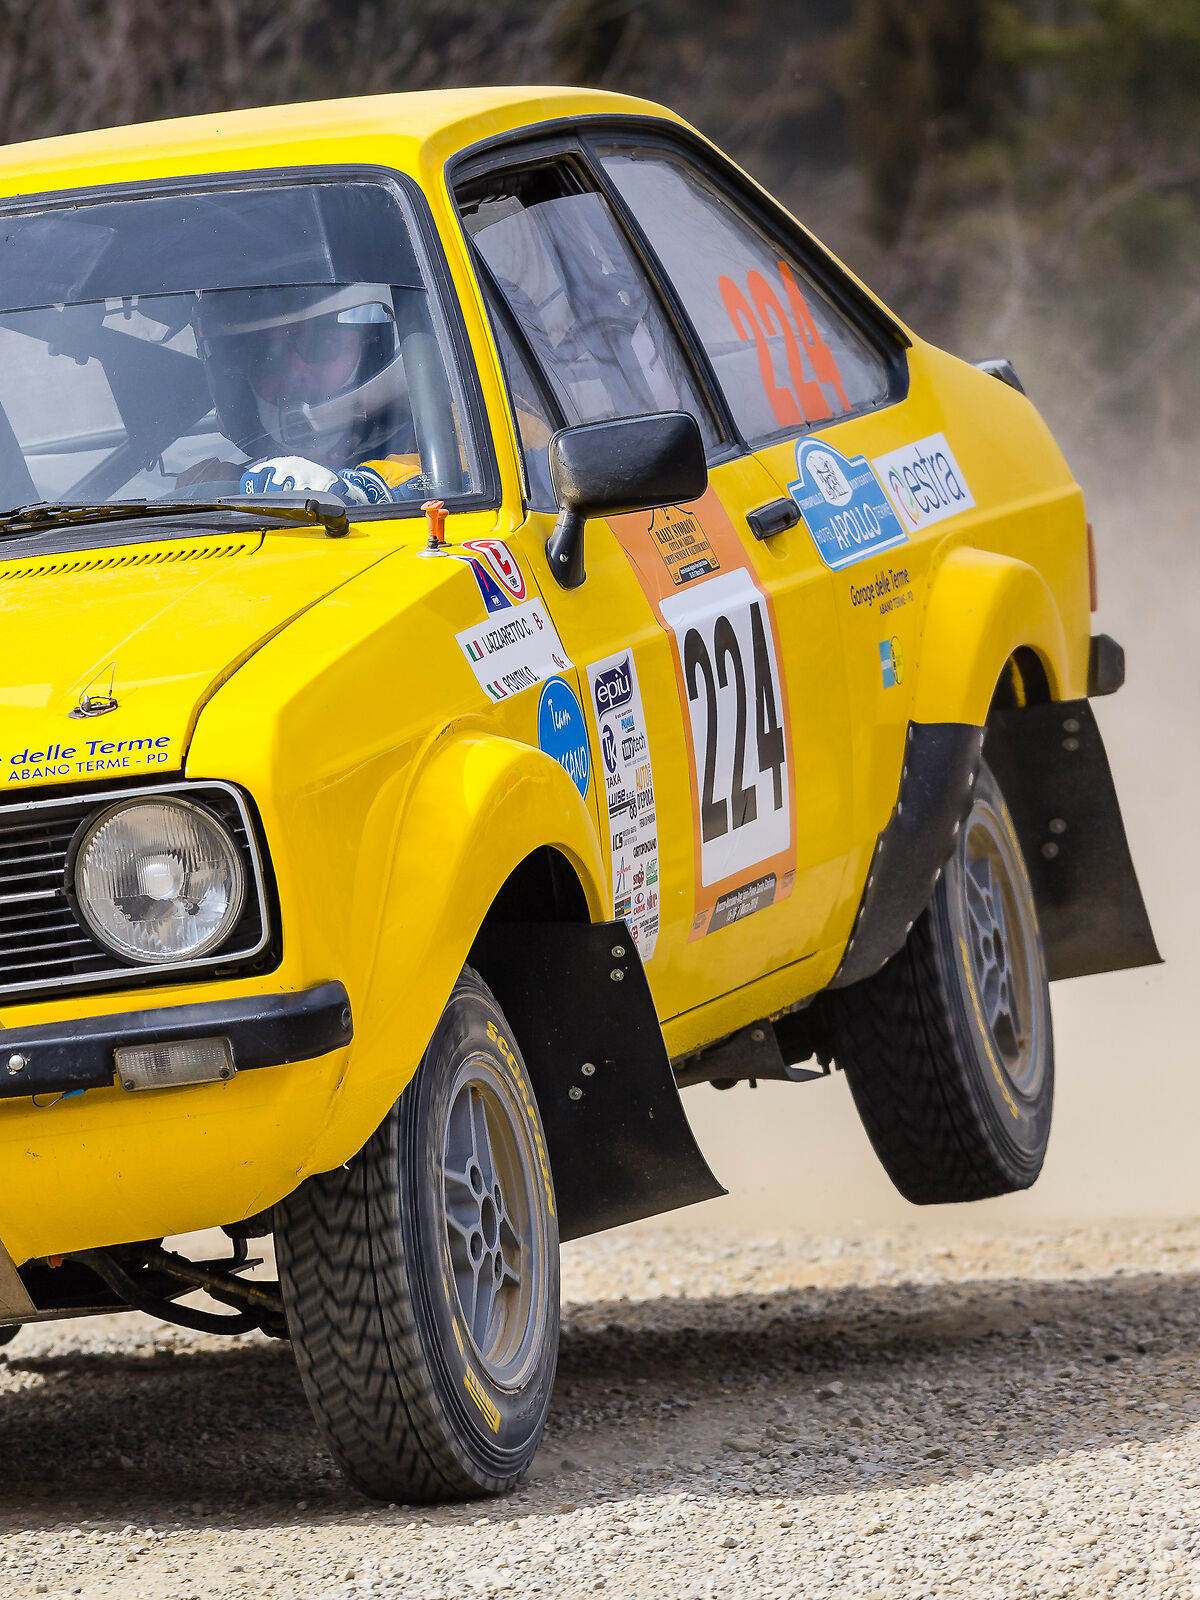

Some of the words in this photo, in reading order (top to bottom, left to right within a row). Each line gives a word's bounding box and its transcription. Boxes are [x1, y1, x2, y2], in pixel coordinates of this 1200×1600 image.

[717, 261, 853, 427] 224
[829, 503, 881, 550] APOLLO
[850, 583, 875, 606] Garage
[875, 571, 891, 597] delle
[888, 568, 910, 590] Terme
[481, 619, 526, 654] LAZZARETTO
[547, 698, 571, 732] Team
[683, 601, 785, 843] 224
[8, 763, 71, 781] ABANO
[75, 757, 130, 773] TERME
[147, 752, 169, 765] PD
[10, 744, 77, 766] delle
[85, 735, 171, 756] Terme
[606, 772, 621, 788] TAKA
